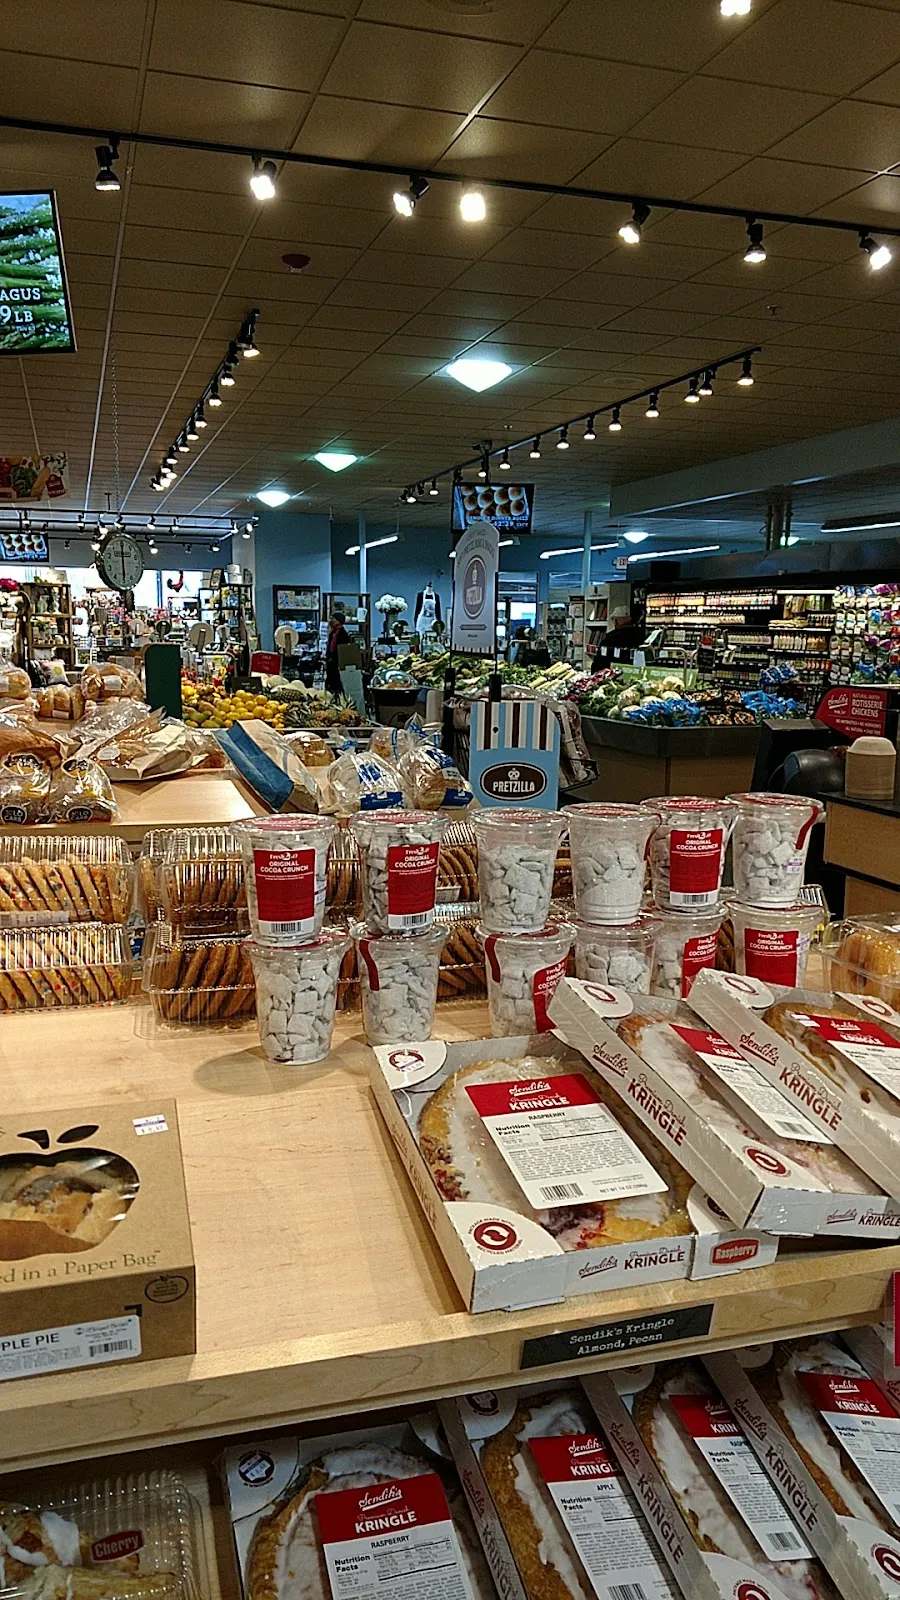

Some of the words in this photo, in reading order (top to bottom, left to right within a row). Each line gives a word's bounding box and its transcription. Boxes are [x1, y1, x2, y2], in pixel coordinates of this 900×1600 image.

[14, 310, 33, 322] LB
[851, 707, 878, 717] CHICKENS
[852, 699, 883, 709] ROTISSERIE
[493, 781, 535, 793] PRETZILLA
[283, 865, 309, 873] CRUNCH
[739, 1032, 780, 1067] Sendik's
[592, 1041, 629, 1078] Sendik's
[509, 1080, 552, 1097] Sendik's
[508, 1096, 570, 1111] KRINGLE
[779, 1067, 843, 1131] KRINGLE
[528, 1111, 567, 1121] RASPBERRY
[628, 1078, 688, 1146] KRINGLE
[495, 1123, 531, 1132] Nutrition
[858, 1214, 900, 1227] KRINGLE
[715, 1243, 757, 1260] Raspberry
[578, 1255, 618, 1278] Sendik's
[624, 1251, 686, 1270] KRINGLE
[22, 1267, 41, 1281] in
[48, 1267, 57, 1277] a
[65, 1259, 117, 1276] Paper
[35, 1332, 60, 1346] PIE
[569, 1327, 623, 1345] Sendik's
[626, 1317, 675, 1333] Kringle
[576, 1340, 625, 1356] Almond,
[628, 1333, 663, 1346] Pecan
[835, 1400, 880, 1413] KRINGLE
[733, 1397, 768, 1441] Sendik's
[609, 1422, 640, 1469] Sendik's
[765, 1446, 818, 1532] KRINGLE
[358, 1485, 403, 1512] Sendik's
[560, 1496, 592, 1505] Nutrition
[354, 1511, 418, 1534] KRINGLE
[637, 1473, 684, 1565] KRINGLE
[94, 1535, 139, 1558] Cherry
[371, 1534, 411, 1549] RASPBERRY
[334, 1554, 371, 1566] Nutrition
[336, 1564, 359, 1573] Facts
